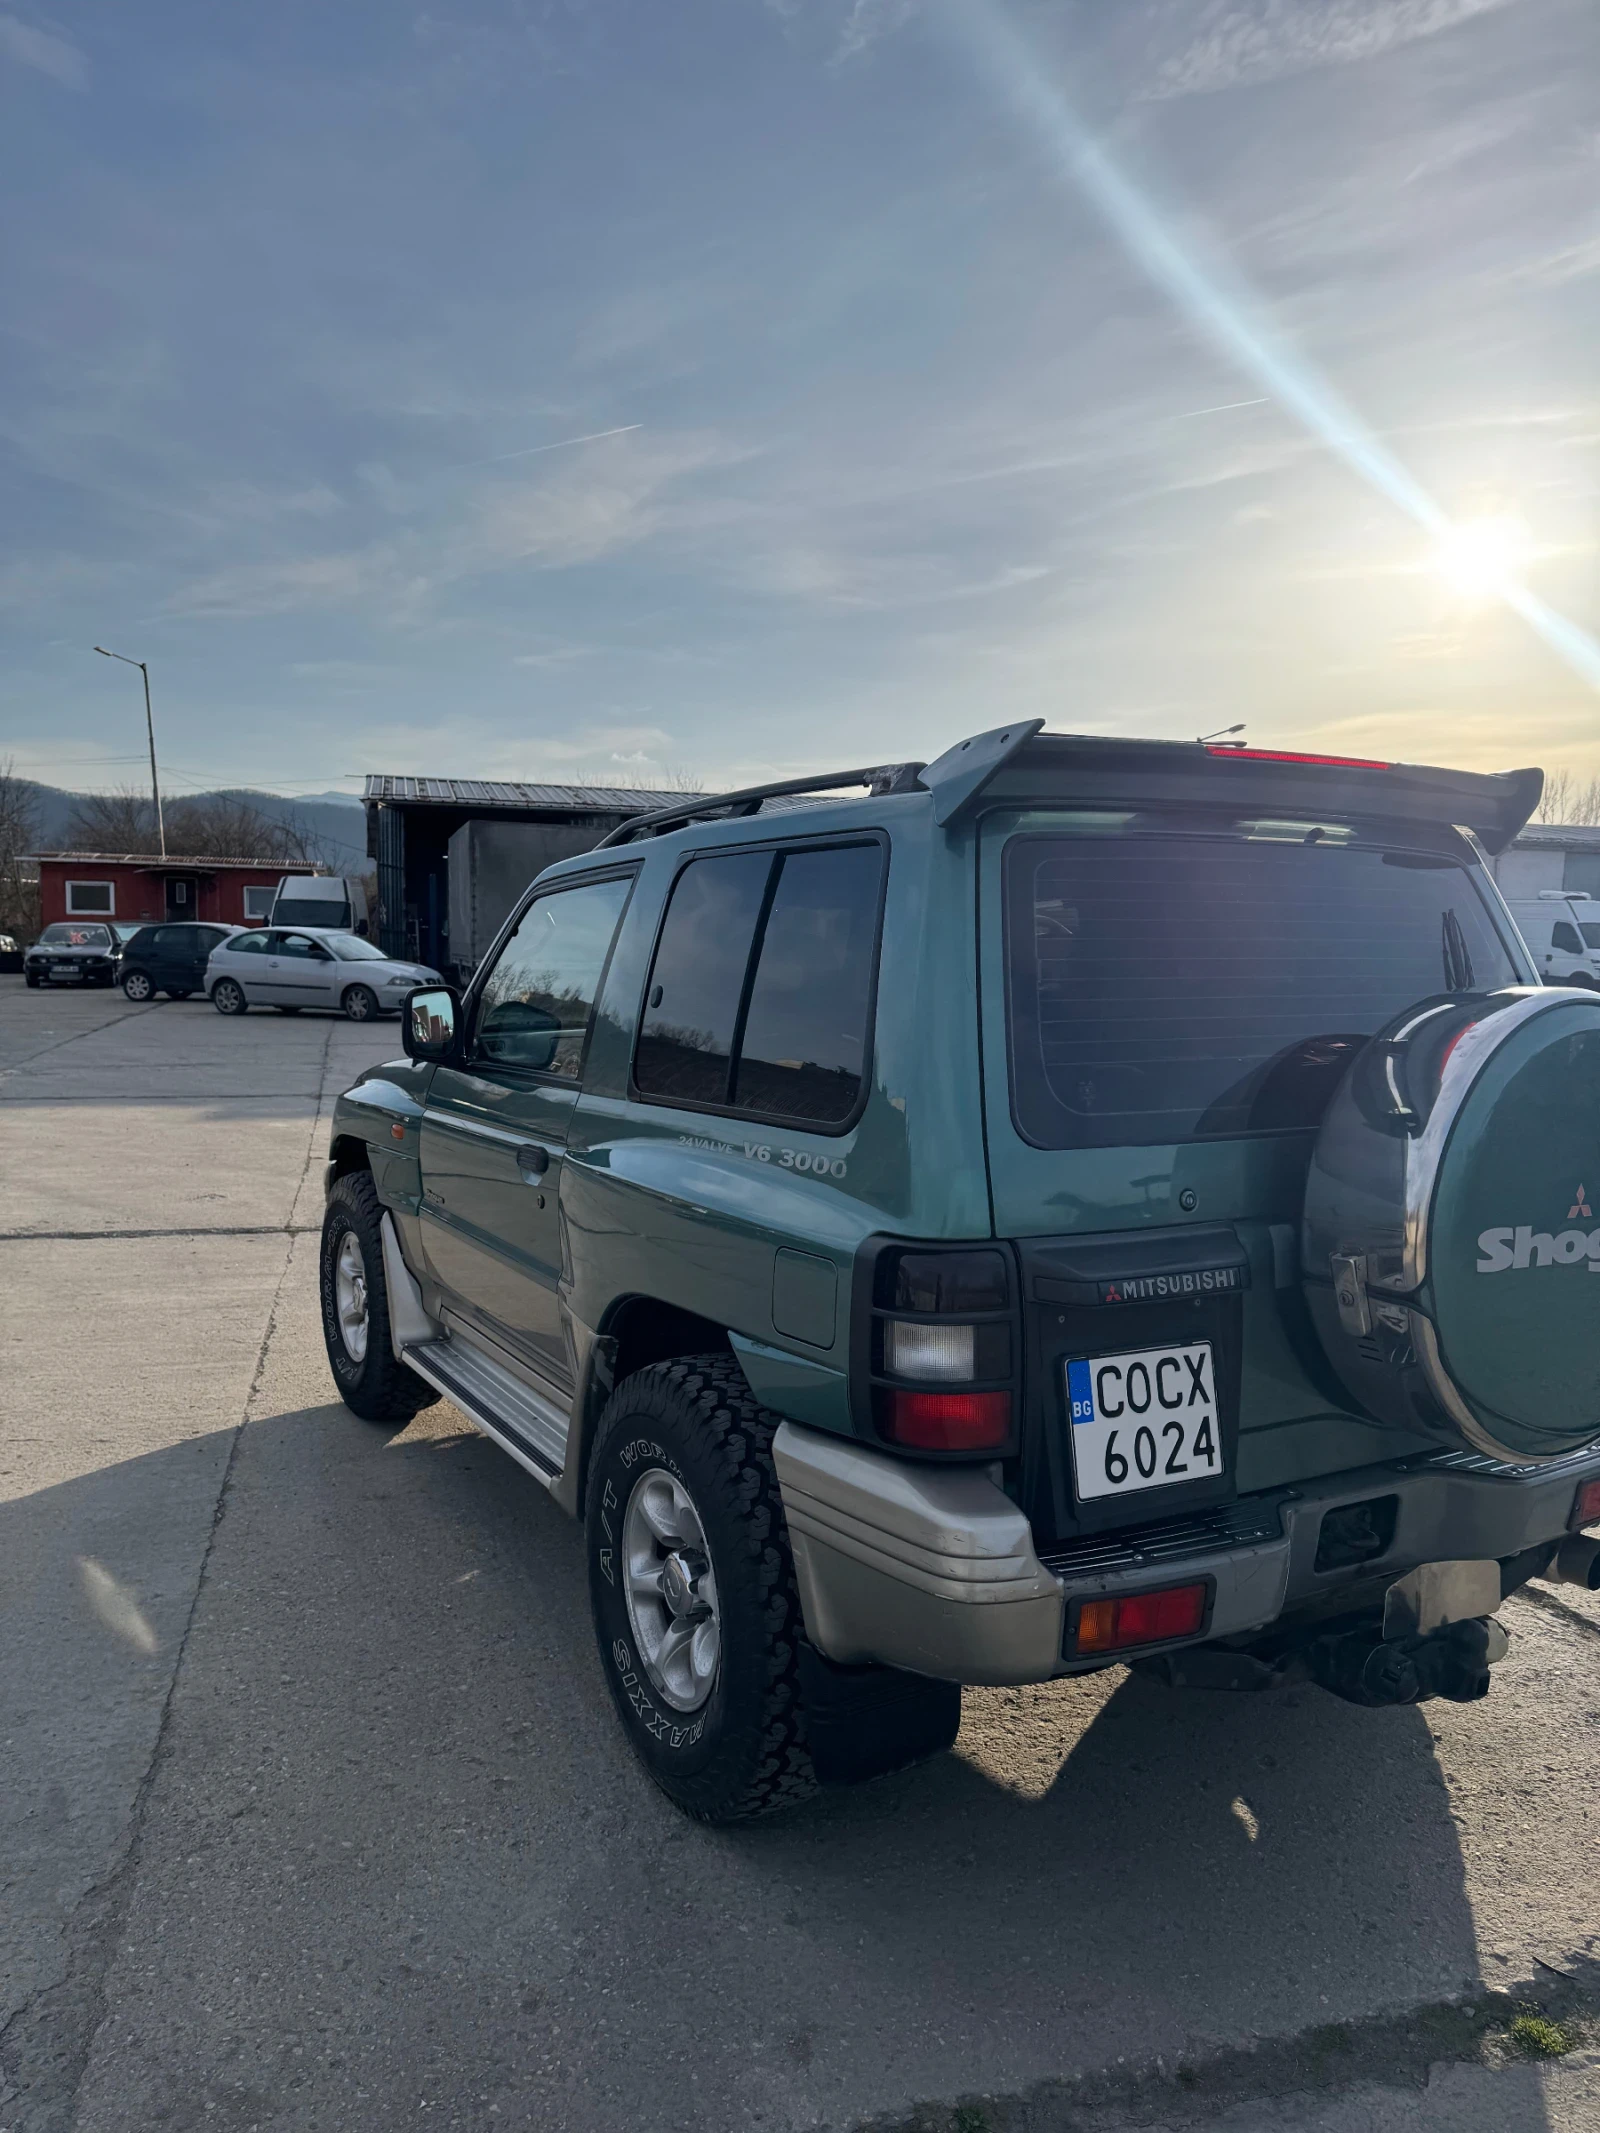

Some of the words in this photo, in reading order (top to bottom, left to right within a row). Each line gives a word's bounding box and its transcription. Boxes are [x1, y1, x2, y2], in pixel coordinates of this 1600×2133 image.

[743, 1140, 772, 1163] V6
[778, 1148, 848, 1179] 3000
[1122, 1269, 1236, 1300] MITSUBISHI
[1073, 1400, 1092, 1418] BG
[1104, 1416, 1216, 1484] 6024
